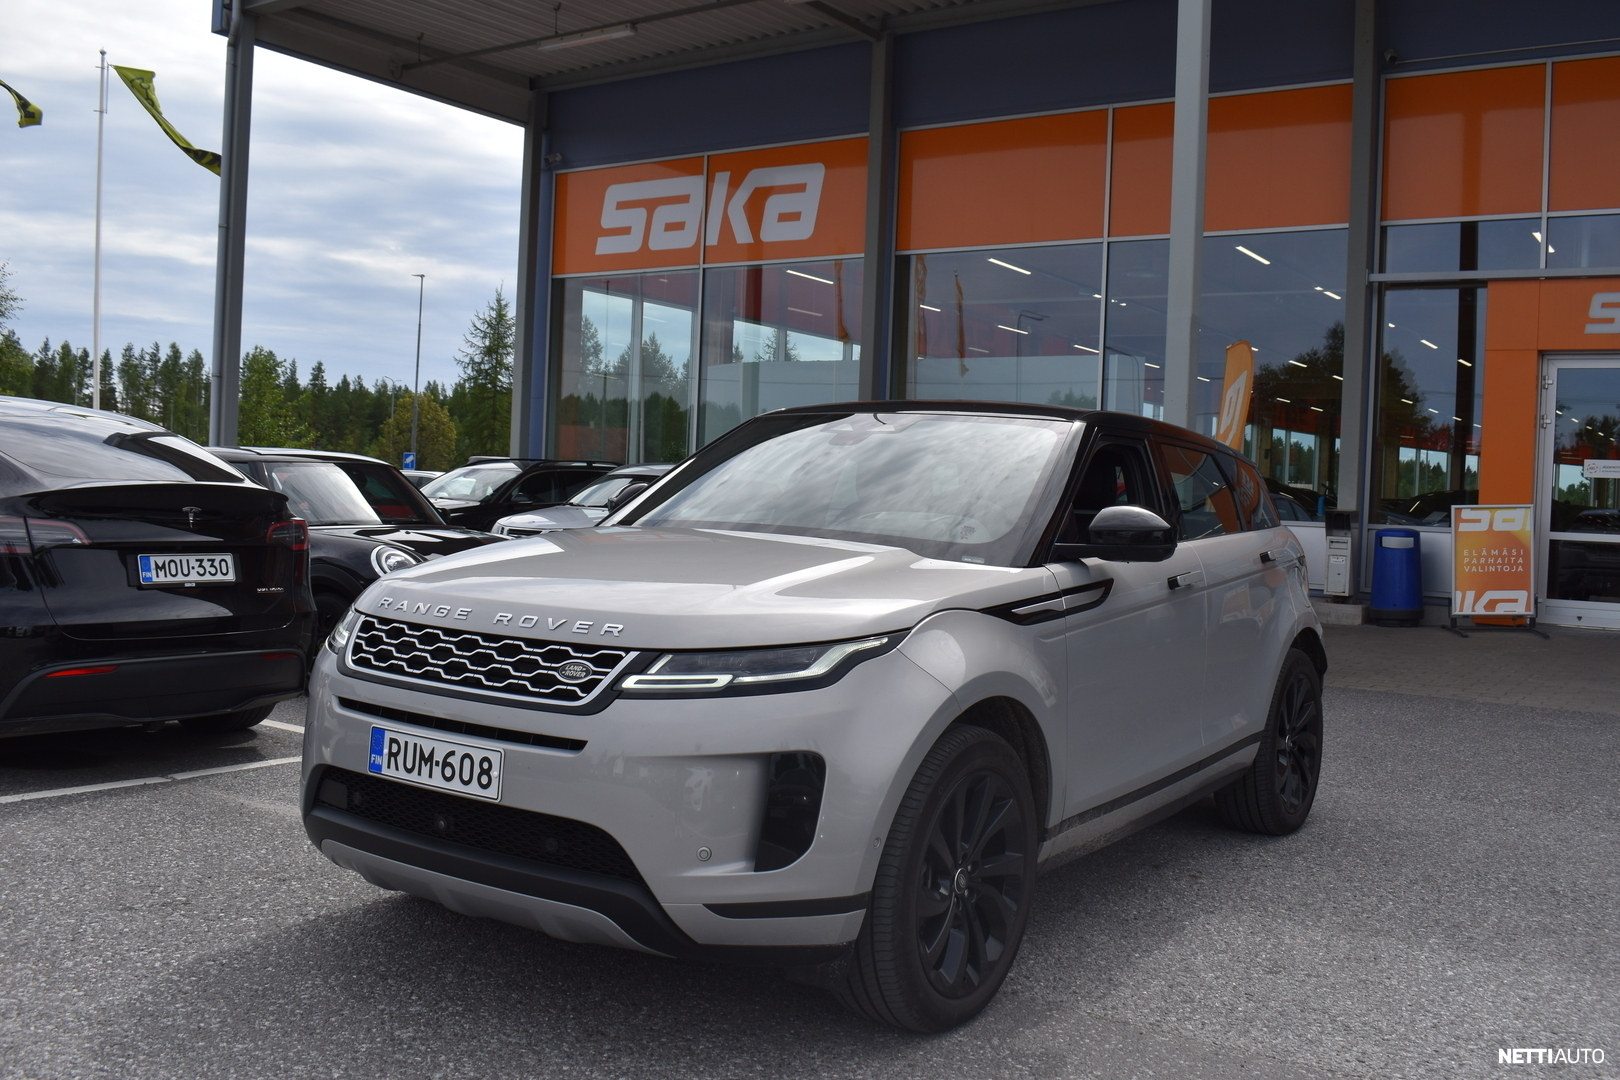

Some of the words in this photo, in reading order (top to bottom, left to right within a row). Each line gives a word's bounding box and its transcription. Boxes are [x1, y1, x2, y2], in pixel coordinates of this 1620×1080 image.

[1463, 547, 1524, 557] ELÄMÄSI
[154, 558, 230, 578] MOU-330
[1463, 565, 1524, 573] VALINTOJA
[378, 597, 472, 620] RANGE
[493, 612, 625, 637] ROVER
[371, 753, 383, 766] FIN
[386, 737, 494, 790] RUM-608
